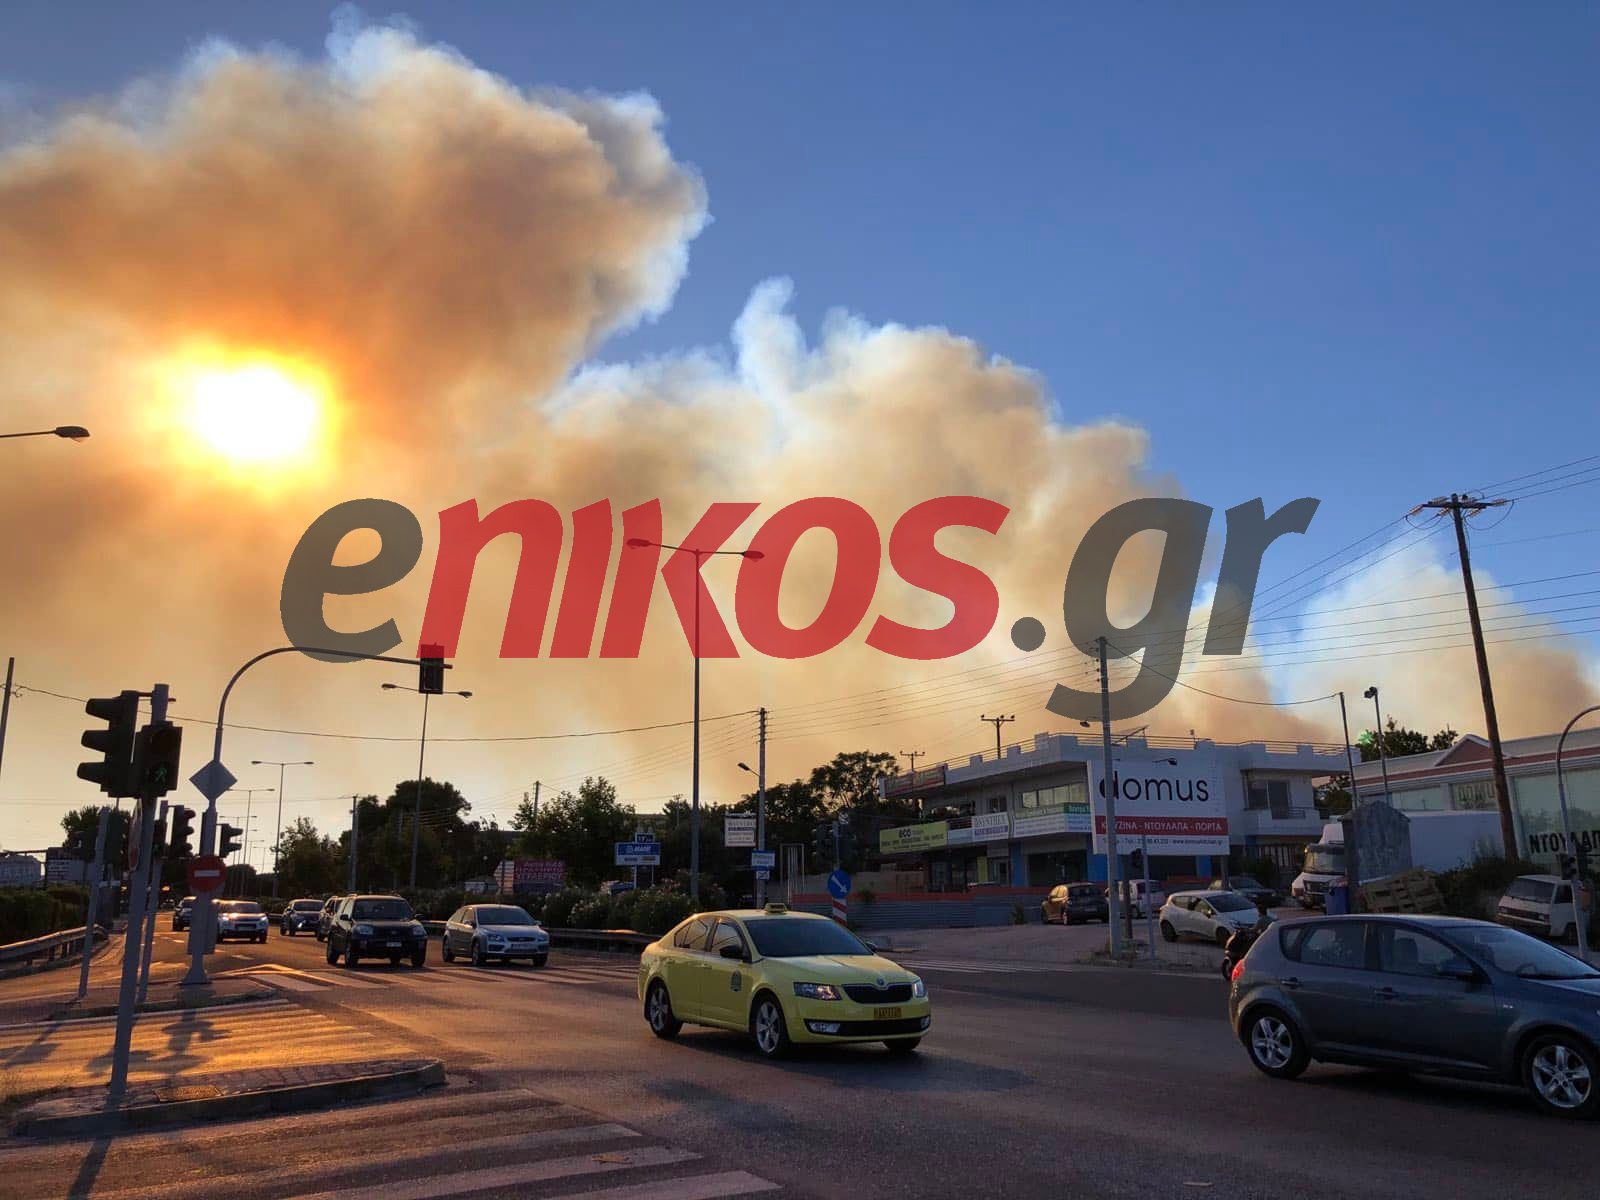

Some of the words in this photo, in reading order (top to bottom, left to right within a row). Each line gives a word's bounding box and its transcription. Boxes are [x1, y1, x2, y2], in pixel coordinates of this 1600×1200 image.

[1099, 770, 1209, 802] domus
[1144, 821, 1189, 831] ΝΤΟΥΛΑΠΑ
[1195, 822, 1222, 832] ΠΟΡΤΑ
